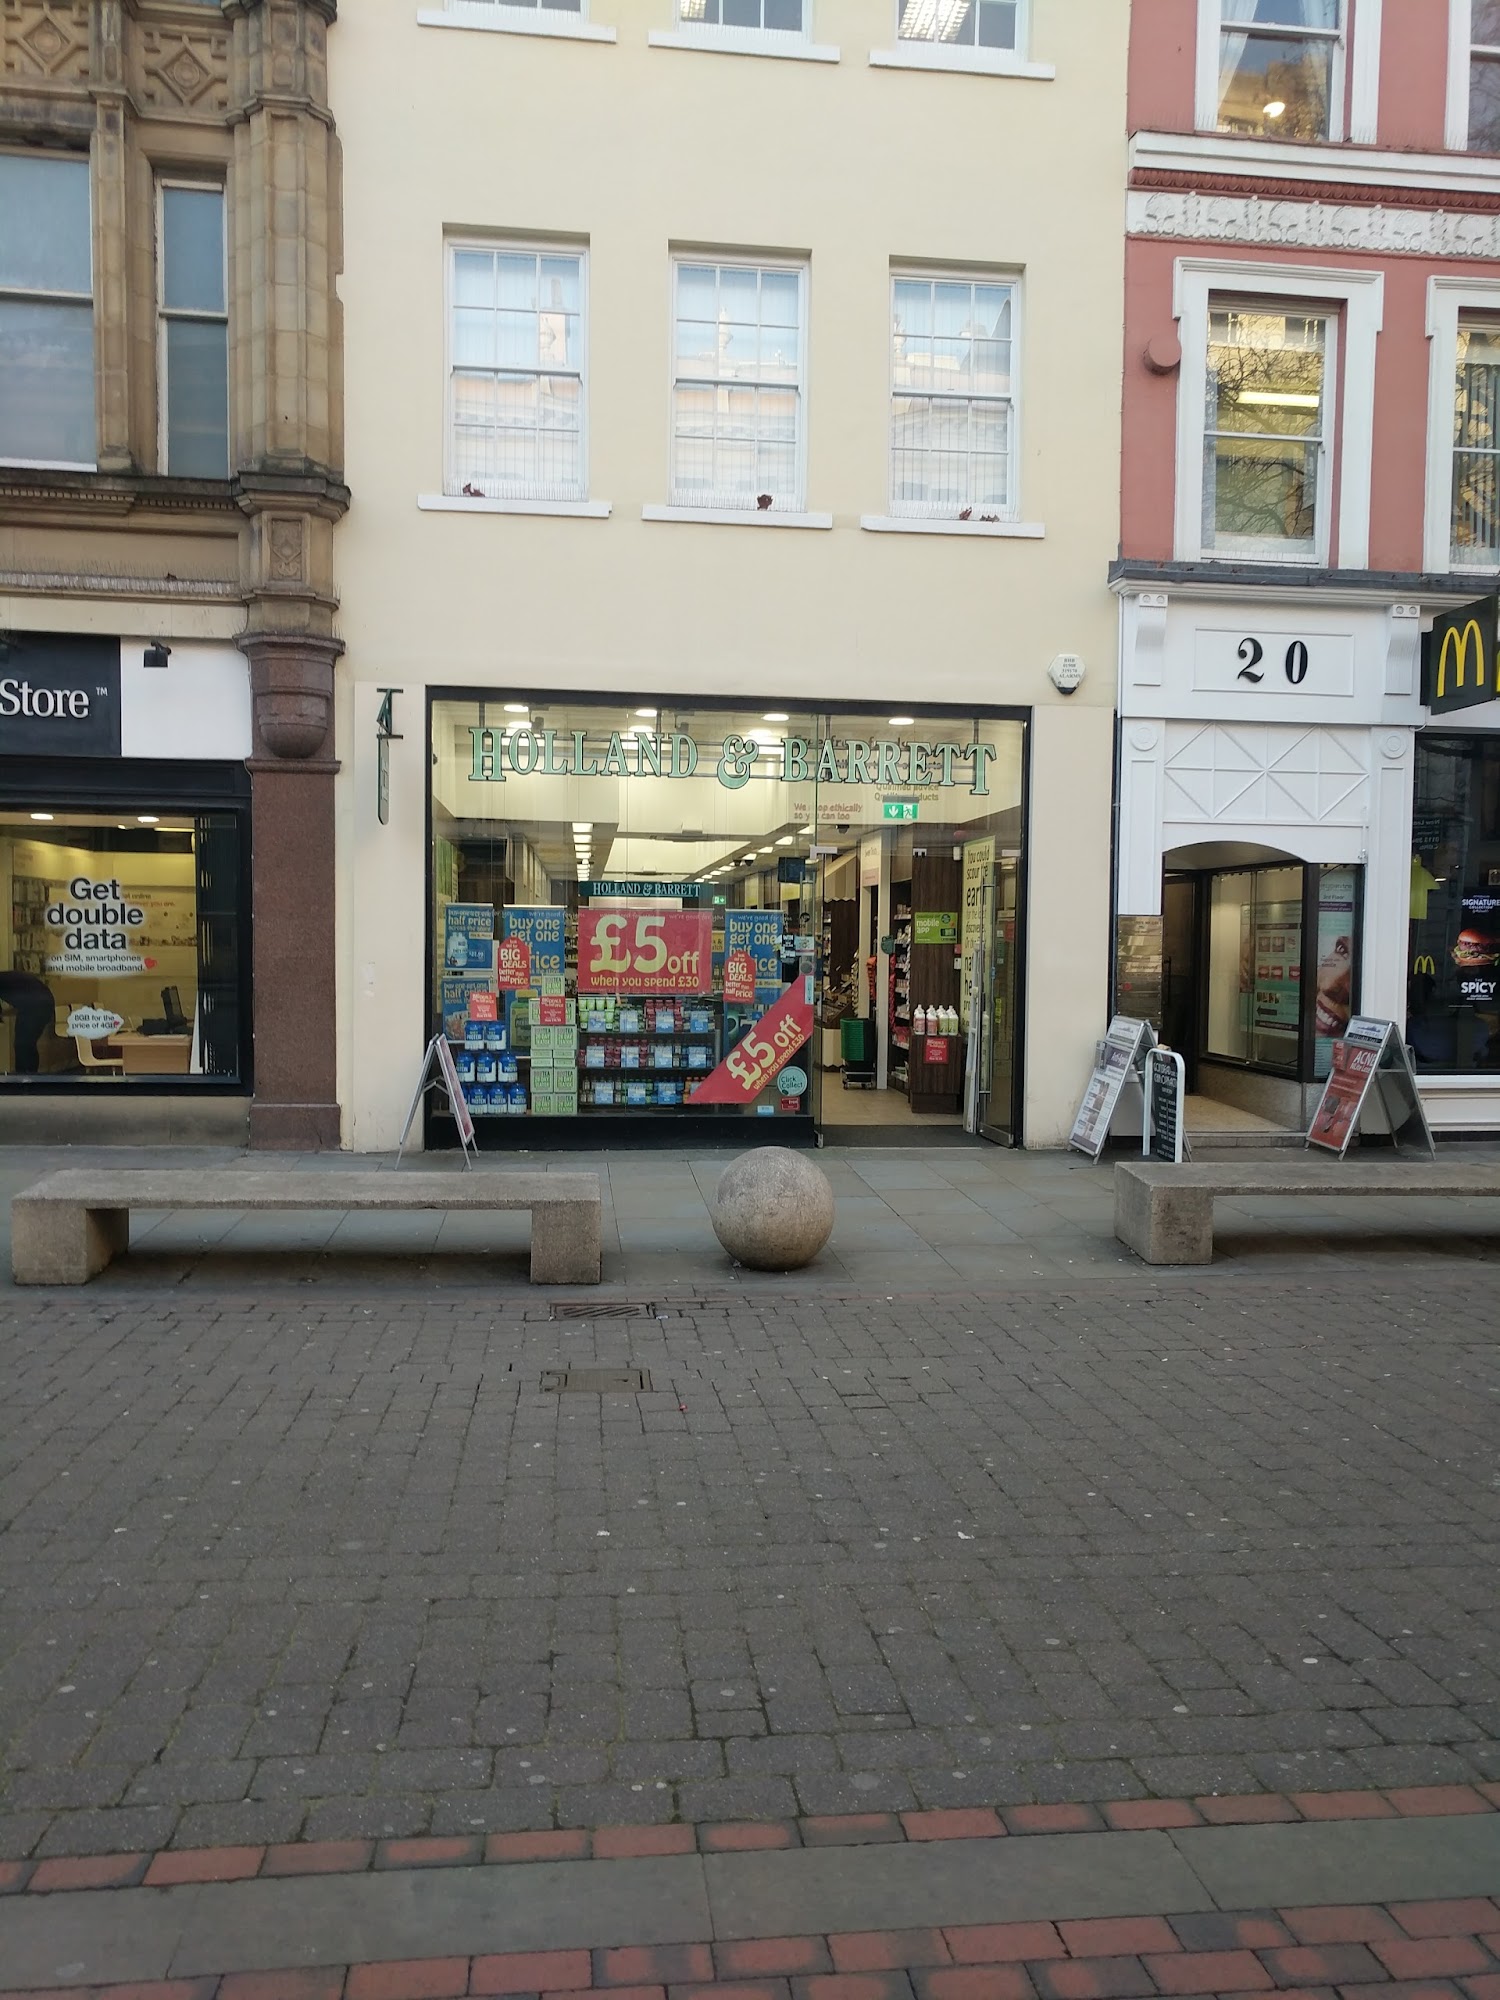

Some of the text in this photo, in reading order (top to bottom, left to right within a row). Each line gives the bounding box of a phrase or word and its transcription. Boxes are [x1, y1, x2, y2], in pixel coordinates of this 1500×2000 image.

[0, 678, 90, 719] Store
[468, 727, 998, 795] HOLLAND & BARRETT
[829, 803, 863, 813] ethically
[837, 812, 850, 820] too
[70, 878, 121, 900] Get
[593, 882, 701, 897] HOLLAND & BARRETT
[1462, 898, 1500, 906] SIGNATURE
[47, 903, 144, 925] double
[448, 916, 492, 927] half price
[509, 915, 561, 931] buy one
[729, 918, 779, 934] buy one
[916, 918, 940, 927] mobile
[535, 930, 560, 942] one
[916, 926, 930, 934] app
[65, 928, 127, 950] data
[589, 914, 700, 974] £5 off
[729, 933, 751, 945] get
[754, 934, 778, 946] one
[64, 954, 84, 963] SIM,
[85, 954, 142, 963] smartphones
[500, 949, 520, 960] BIG
[530, 950, 560, 969] rice
[48, 963, 146, 972] and mobile broadband.
[502, 960, 528, 969] DEALS
[727, 961, 748, 974] BIG
[510, 977, 529, 985] price
[590, 975, 700, 988] when you spend £30
[729, 973, 753, 982] DEALS
[725, 987, 753, 998] half price
[1461, 981, 1497, 994] SPICY
[72, 1023, 90, 1031] price
[725, 1013, 802, 1091] £5 off
[753, 1033, 805, 1091] when you spend £30
[780, 1075, 797, 1083] Click
[781, 1081, 804, 1090] Collect
